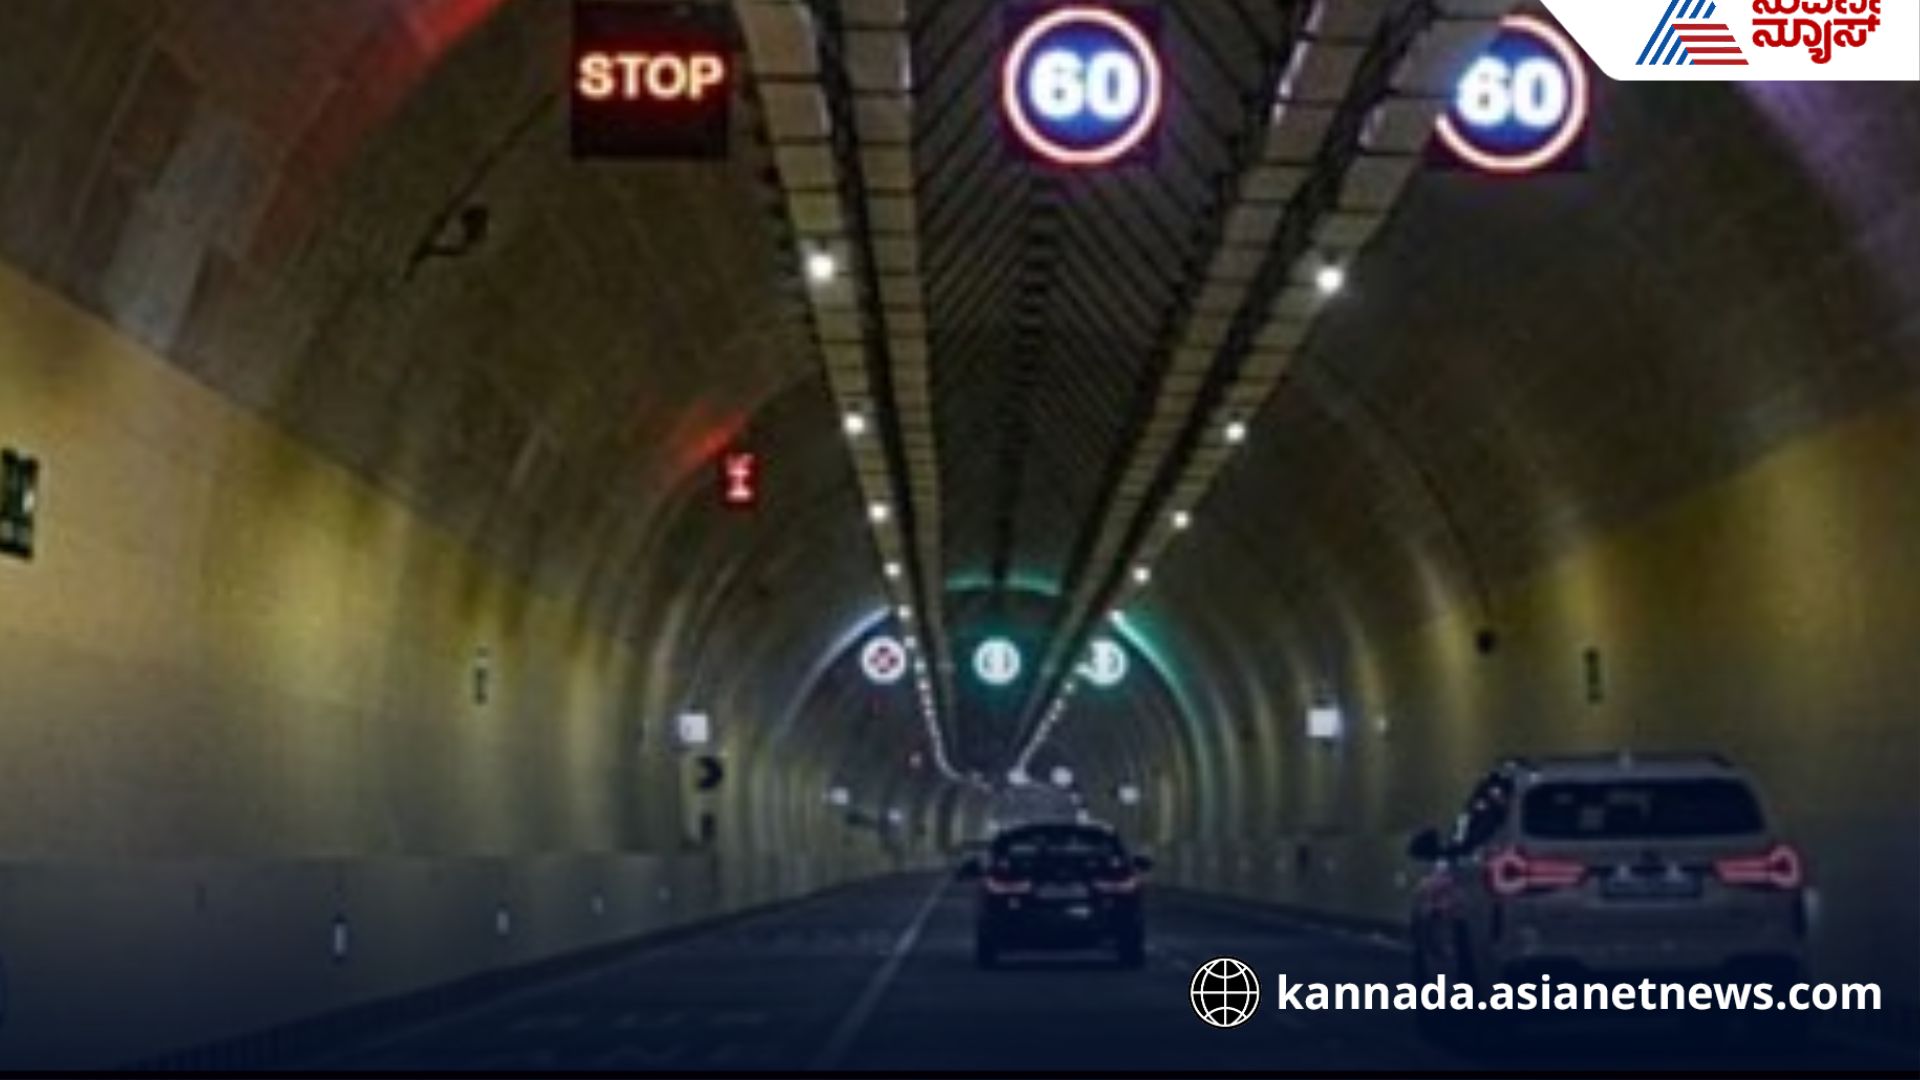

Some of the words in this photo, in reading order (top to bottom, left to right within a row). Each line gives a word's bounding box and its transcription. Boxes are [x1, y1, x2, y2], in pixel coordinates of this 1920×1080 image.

[578, 53, 724, 99] STOP
[1029, 50, 1141, 119] 60
[1456, 55, 1568, 127] 60
